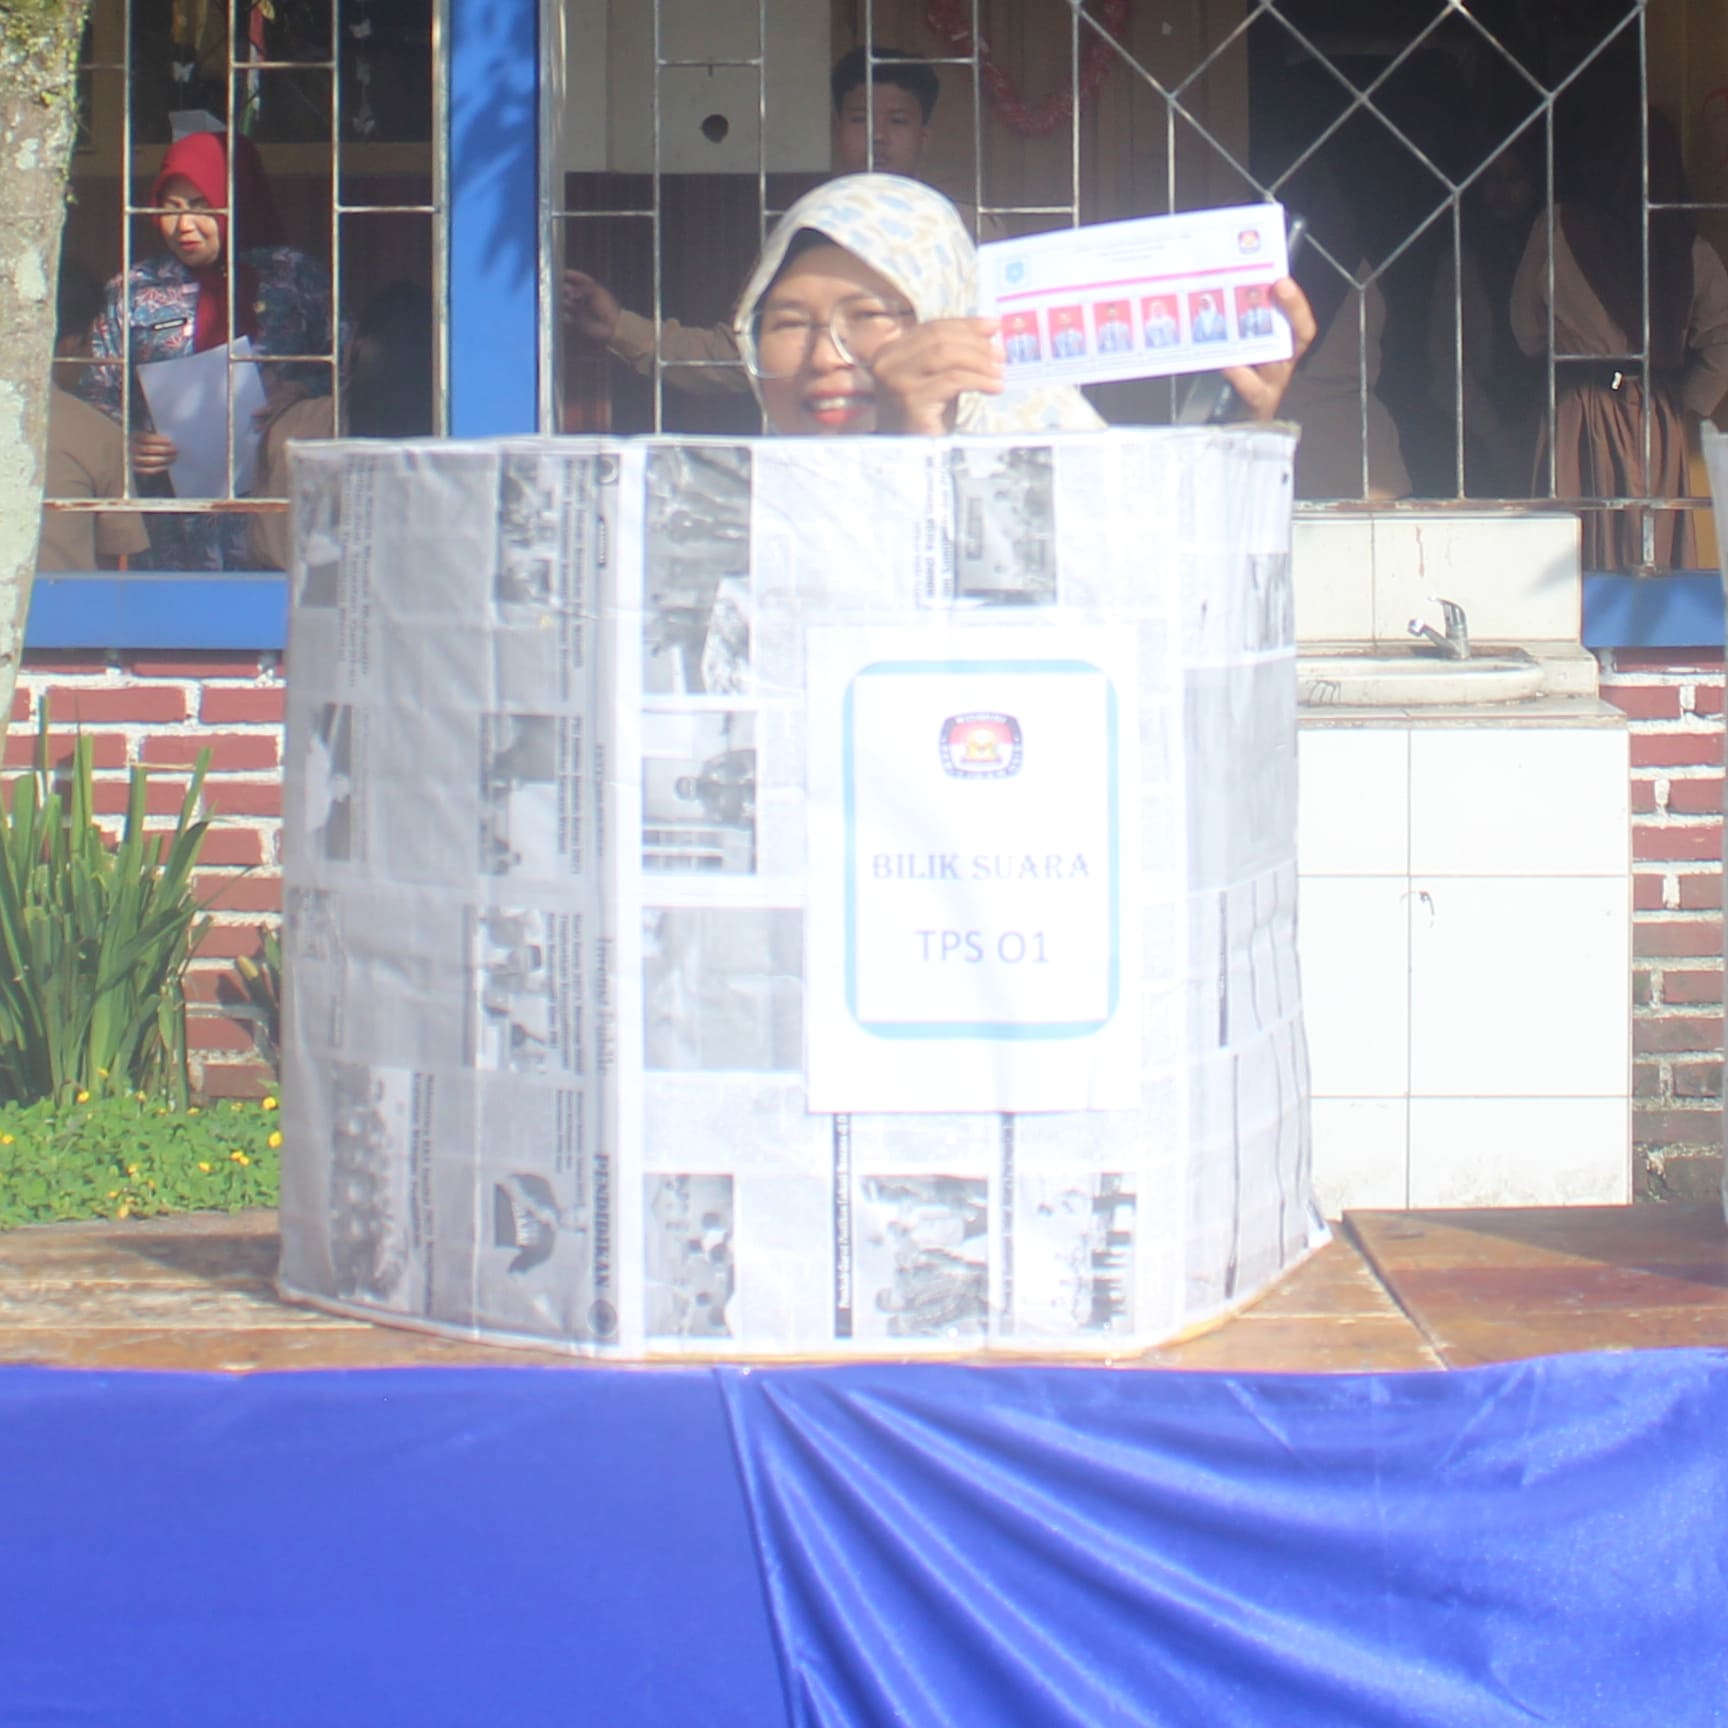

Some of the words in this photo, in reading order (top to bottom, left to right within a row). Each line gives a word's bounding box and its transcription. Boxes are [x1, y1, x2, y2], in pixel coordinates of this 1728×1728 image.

[872, 851, 960, 881] BILIK
[970, 850, 1092, 881] SUARA
[914, 929, 990, 966] TPS
[593, 1152, 612, 1289] PENDIDIKAN
